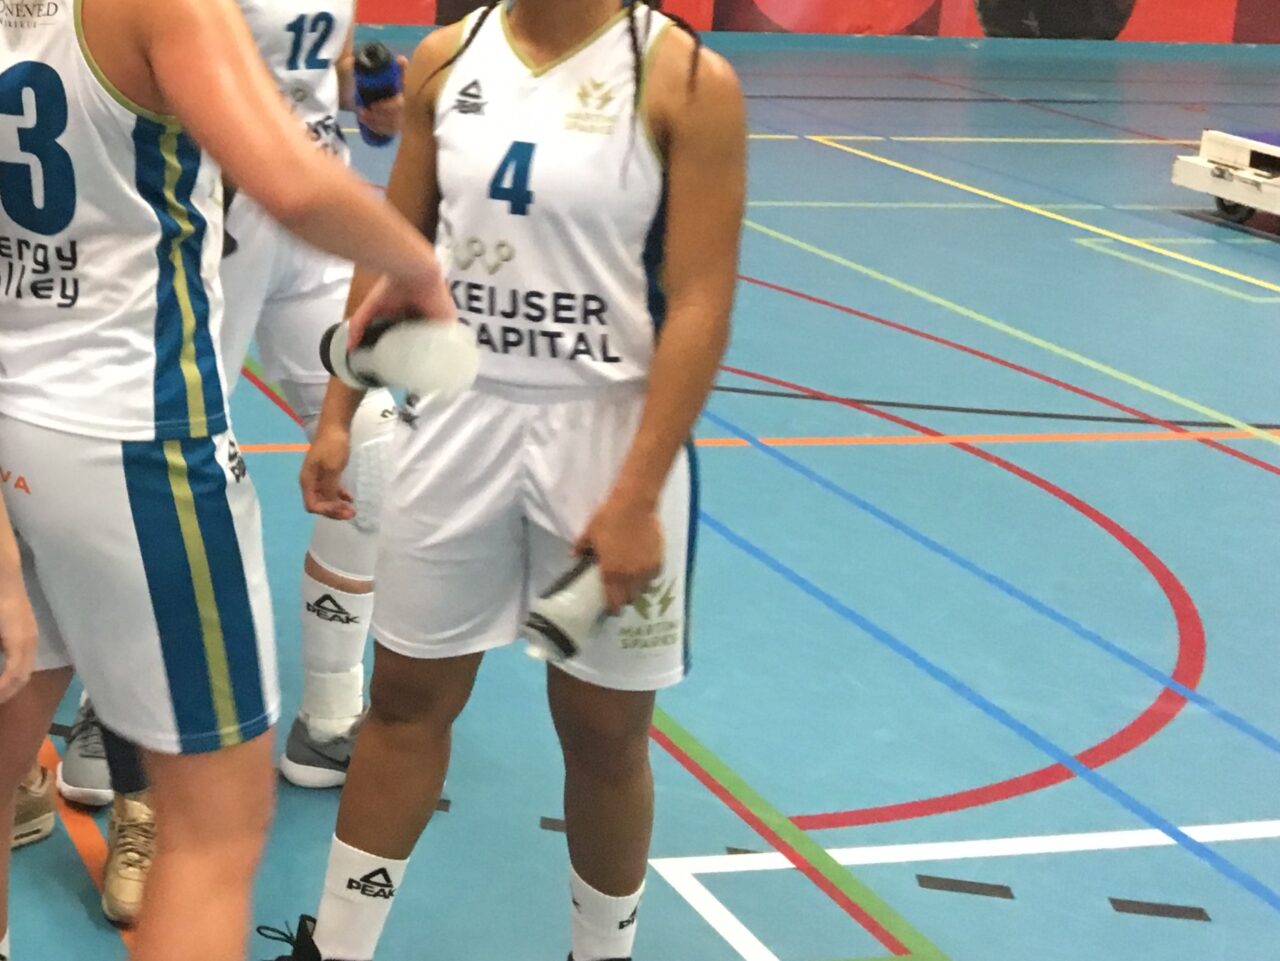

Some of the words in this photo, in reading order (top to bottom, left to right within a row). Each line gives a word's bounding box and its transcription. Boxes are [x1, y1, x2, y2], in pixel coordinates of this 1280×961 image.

[285, 11, 335, 71] 12
[489, 140, 537, 216] 4
[450, 280, 608, 326] KEIJSER
[457, 317, 622, 364] APITAL
[306, 601, 360, 624] PEAK
[346, 877, 397, 899] PEAK
